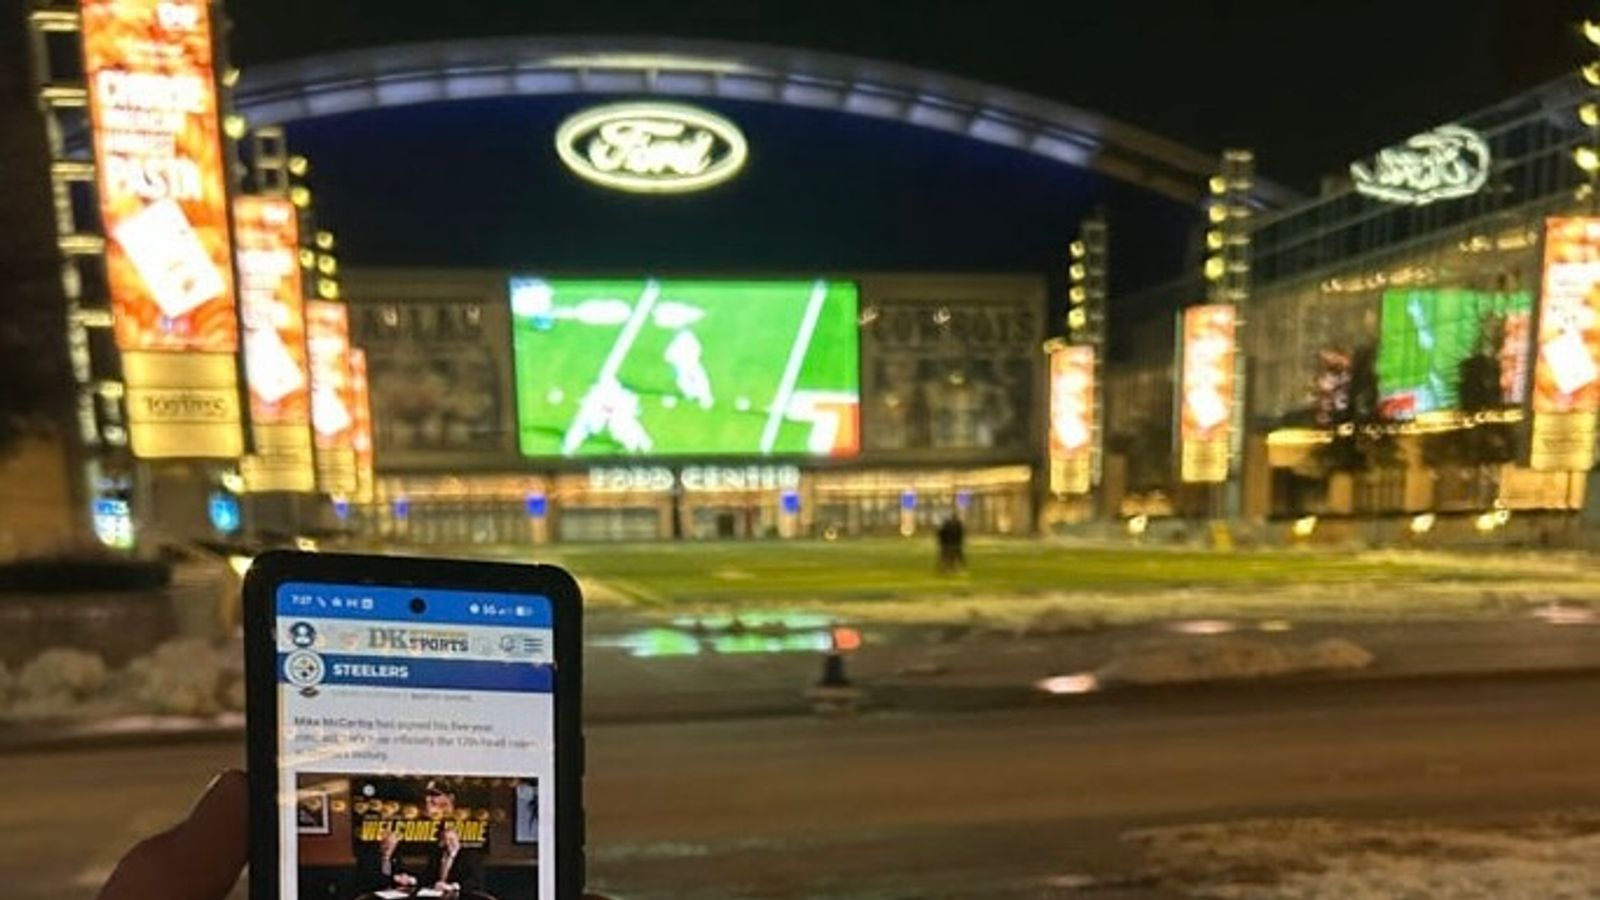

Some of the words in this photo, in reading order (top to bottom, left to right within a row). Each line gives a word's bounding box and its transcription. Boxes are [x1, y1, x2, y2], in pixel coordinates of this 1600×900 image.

[588, 121, 713, 175] Ford
[680, 465, 800, 492] CENTER
[368, 627, 408, 650] DK
[408, 636, 469, 651] SPORTS
[332, 663, 409, 679] STEELERS
